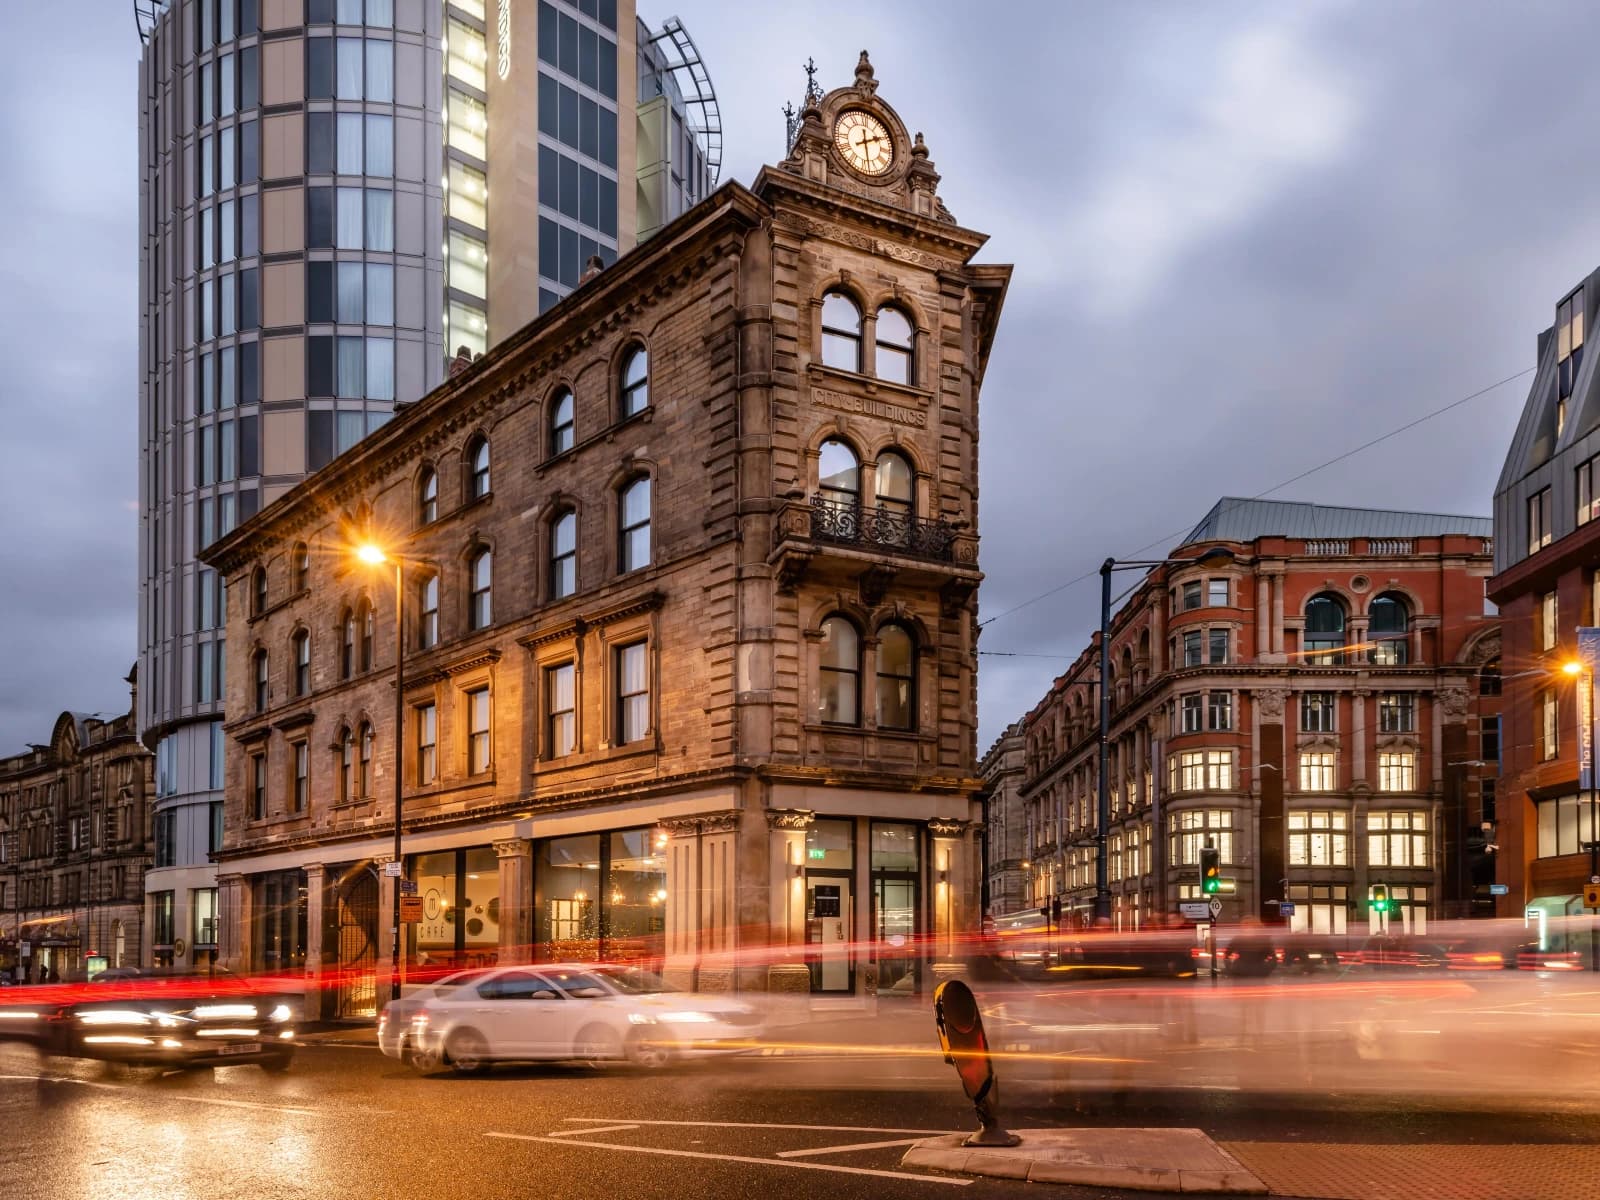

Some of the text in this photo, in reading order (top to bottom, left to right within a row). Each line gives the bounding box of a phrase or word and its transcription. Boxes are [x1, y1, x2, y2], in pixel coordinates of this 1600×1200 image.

[854, 397, 926, 426] BUILDINGS
[1580, 751, 1591, 772] The
[1211, 902, 1220, 910] 10
